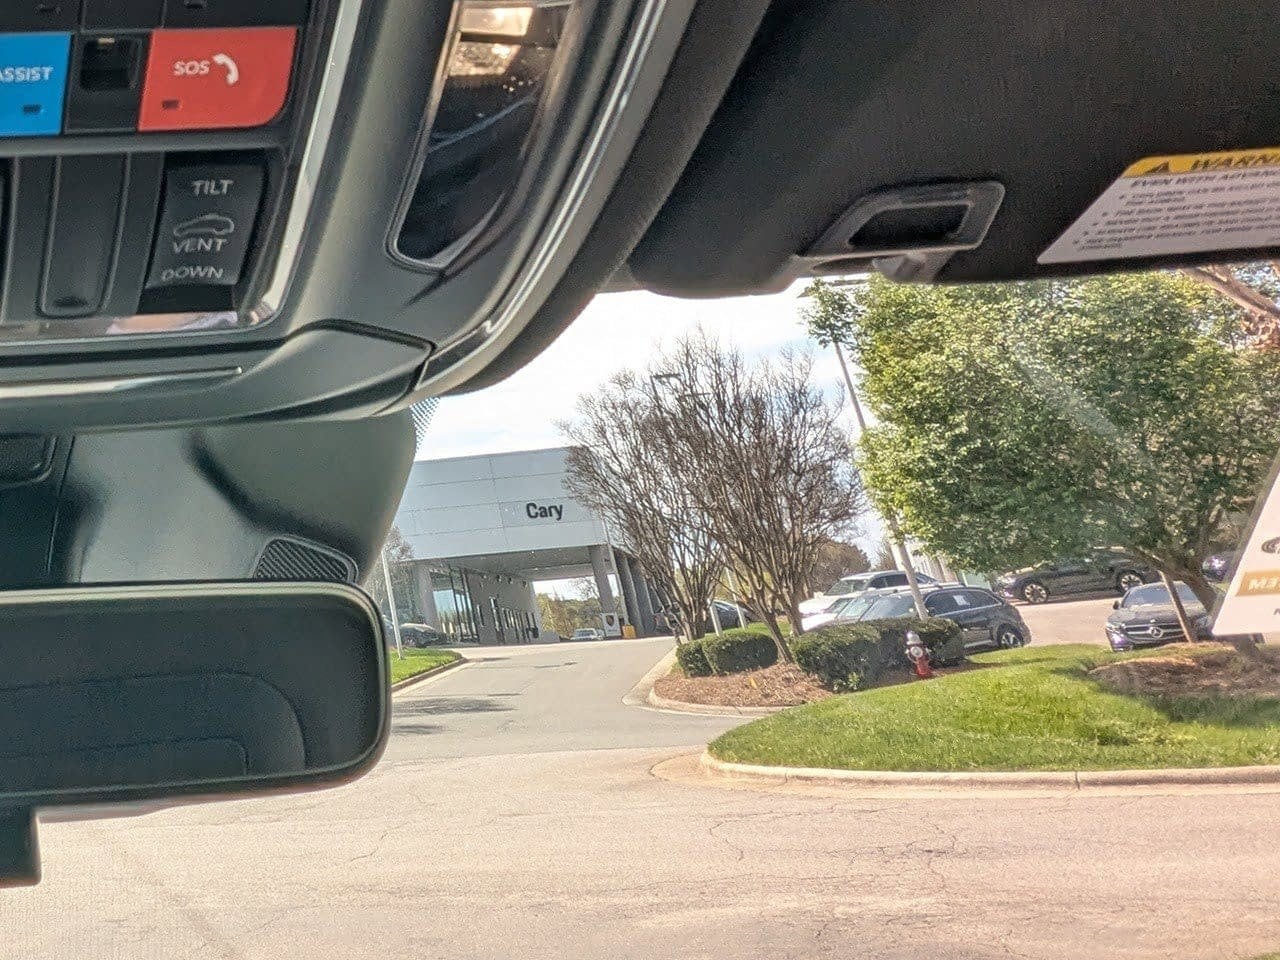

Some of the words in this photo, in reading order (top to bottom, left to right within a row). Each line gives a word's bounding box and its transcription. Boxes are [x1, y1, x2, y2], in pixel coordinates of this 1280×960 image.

[173, 60, 211, 76] SOS
[192, 179, 235, 196] TILT
[172, 238, 227, 254] VENT
[161, 265, 224, 281] DOWN
[526, 502, 563, 521] Cary
